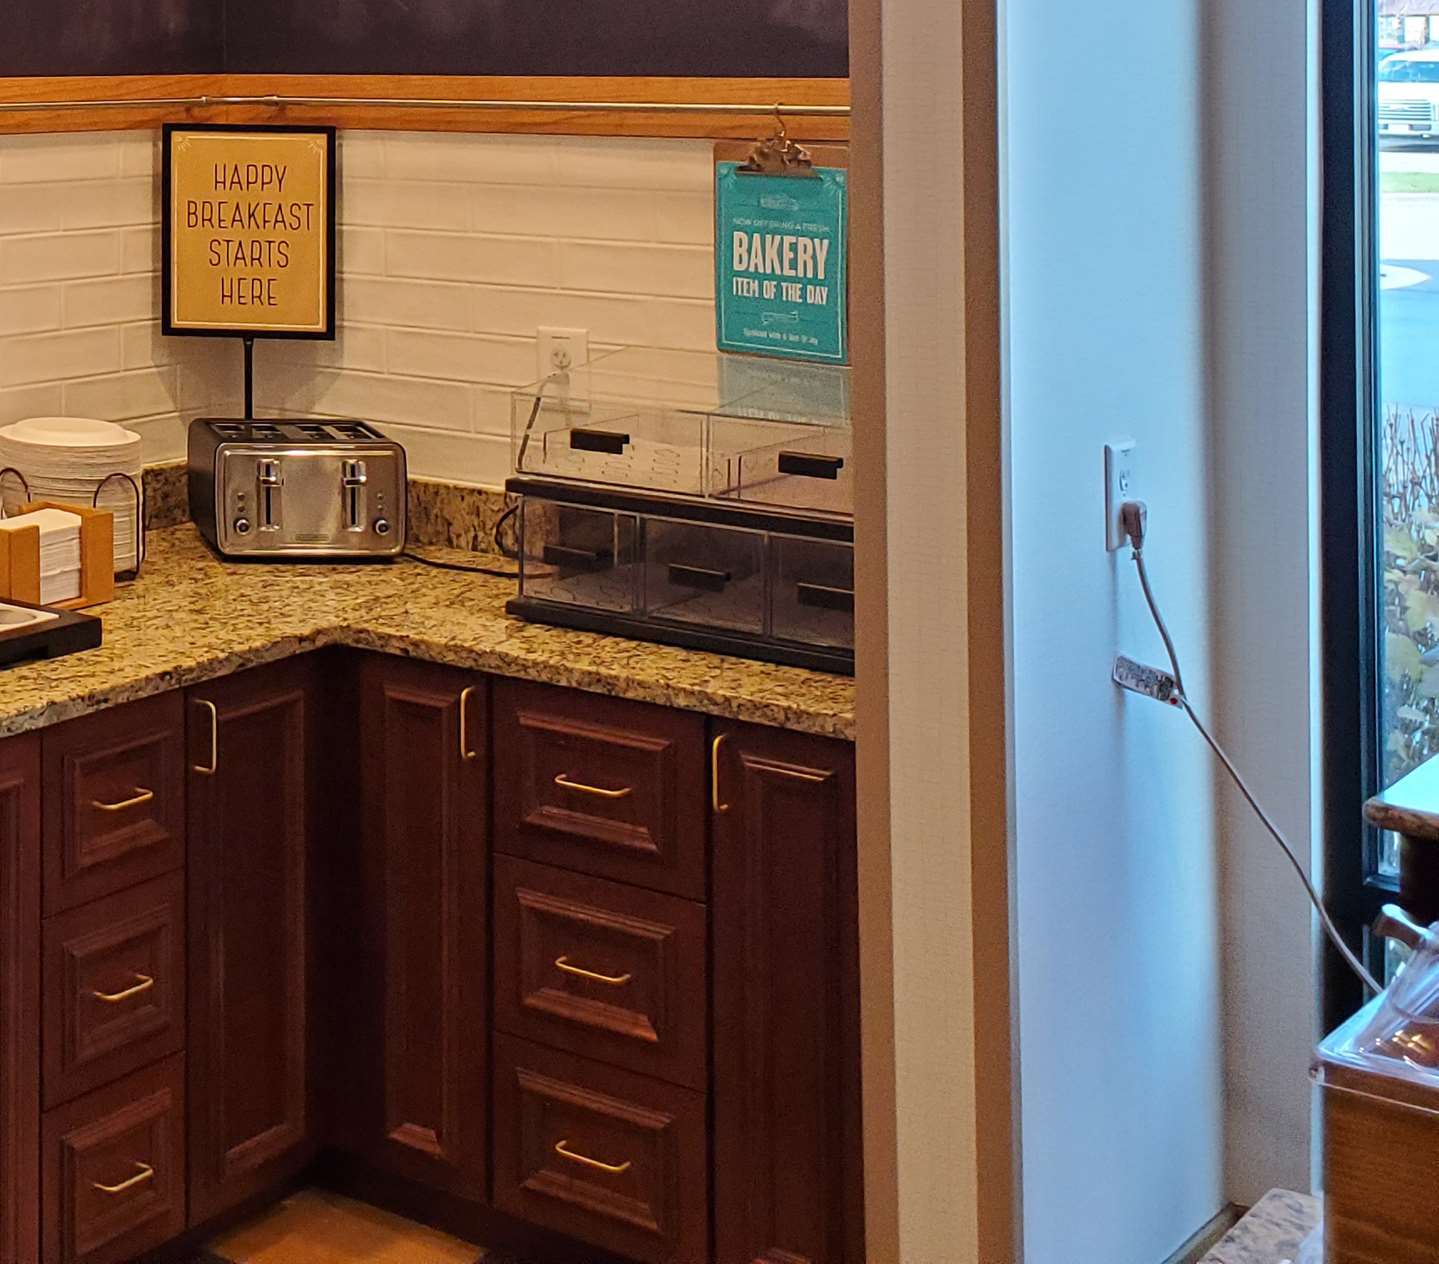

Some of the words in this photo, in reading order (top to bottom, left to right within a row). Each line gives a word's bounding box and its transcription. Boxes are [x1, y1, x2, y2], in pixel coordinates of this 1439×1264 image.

[214, 163, 288, 193] HAPPY
[186, 200, 314, 231] BREAKFAST
[209, 239, 290, 268] STARTS
[733, 231, 830, 280] BAKERY
[221, 276, 278, 306] HERE
[733, 276, 759, 298] ITEM
[763, 280, 777, 300] OF
[780, 282, 803, 303] THE
[806, 285, 829, 305] DAY
